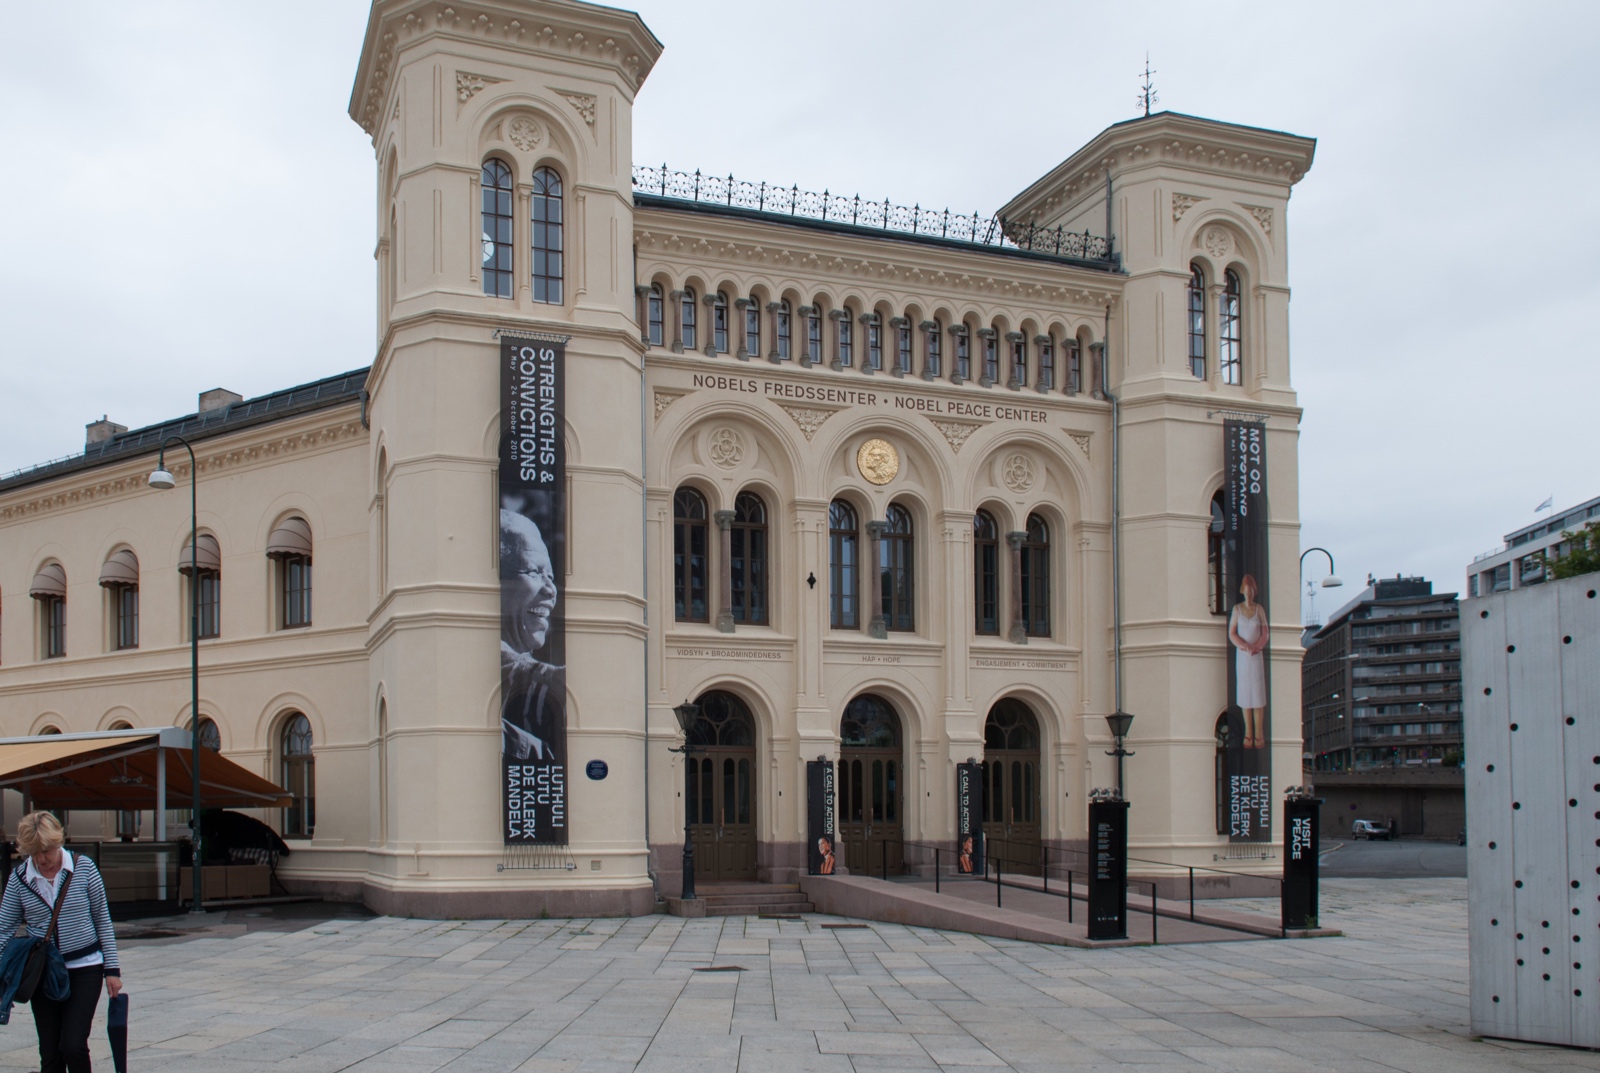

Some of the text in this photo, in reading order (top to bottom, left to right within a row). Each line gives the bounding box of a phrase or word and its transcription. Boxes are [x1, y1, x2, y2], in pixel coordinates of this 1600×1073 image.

[509, 355, 518, 371] May
[510, 385, 518, 395] 24
[693, 374, 1047, 423] NOBELS FREDSSENTER NOBEL PEACE CENTER
[510, 400, 518, 435] October
[519, 346, 536, 482] CONVICTIONS
[539, 348, 555, 483] STRENGTHS &
[510, 440, 518, 460] 2010
[1249, 428, 1261, 494] MOT OG
[711, 650, 782, 659] BROADMINDEDNESS
[882, 656, 901, 664] HOPE
[976, 659, 1067, 669] ENGASJEMENT COMMITMENT
[508, 765, 521, 838] MANDELA
[522, 765, 535, 839] DE KLERK
[537, 765, 550, 804] TUTU
[551, 765, 564, 827] LUTHULI
[826, 794, 833, 805] TO
[963, 795, 969, 805] TO
[1251, 775, 1259, 808] TUTU
[1260, 776, 1269, 828] LUTHULI
[1230, 775, 1240, 836] MANDELA
[1240, 775, 1250, 837] DE KLERK
[1292, 818, 1301, 860] PEACE
[1301, 817, 1311, 849] VISIT
